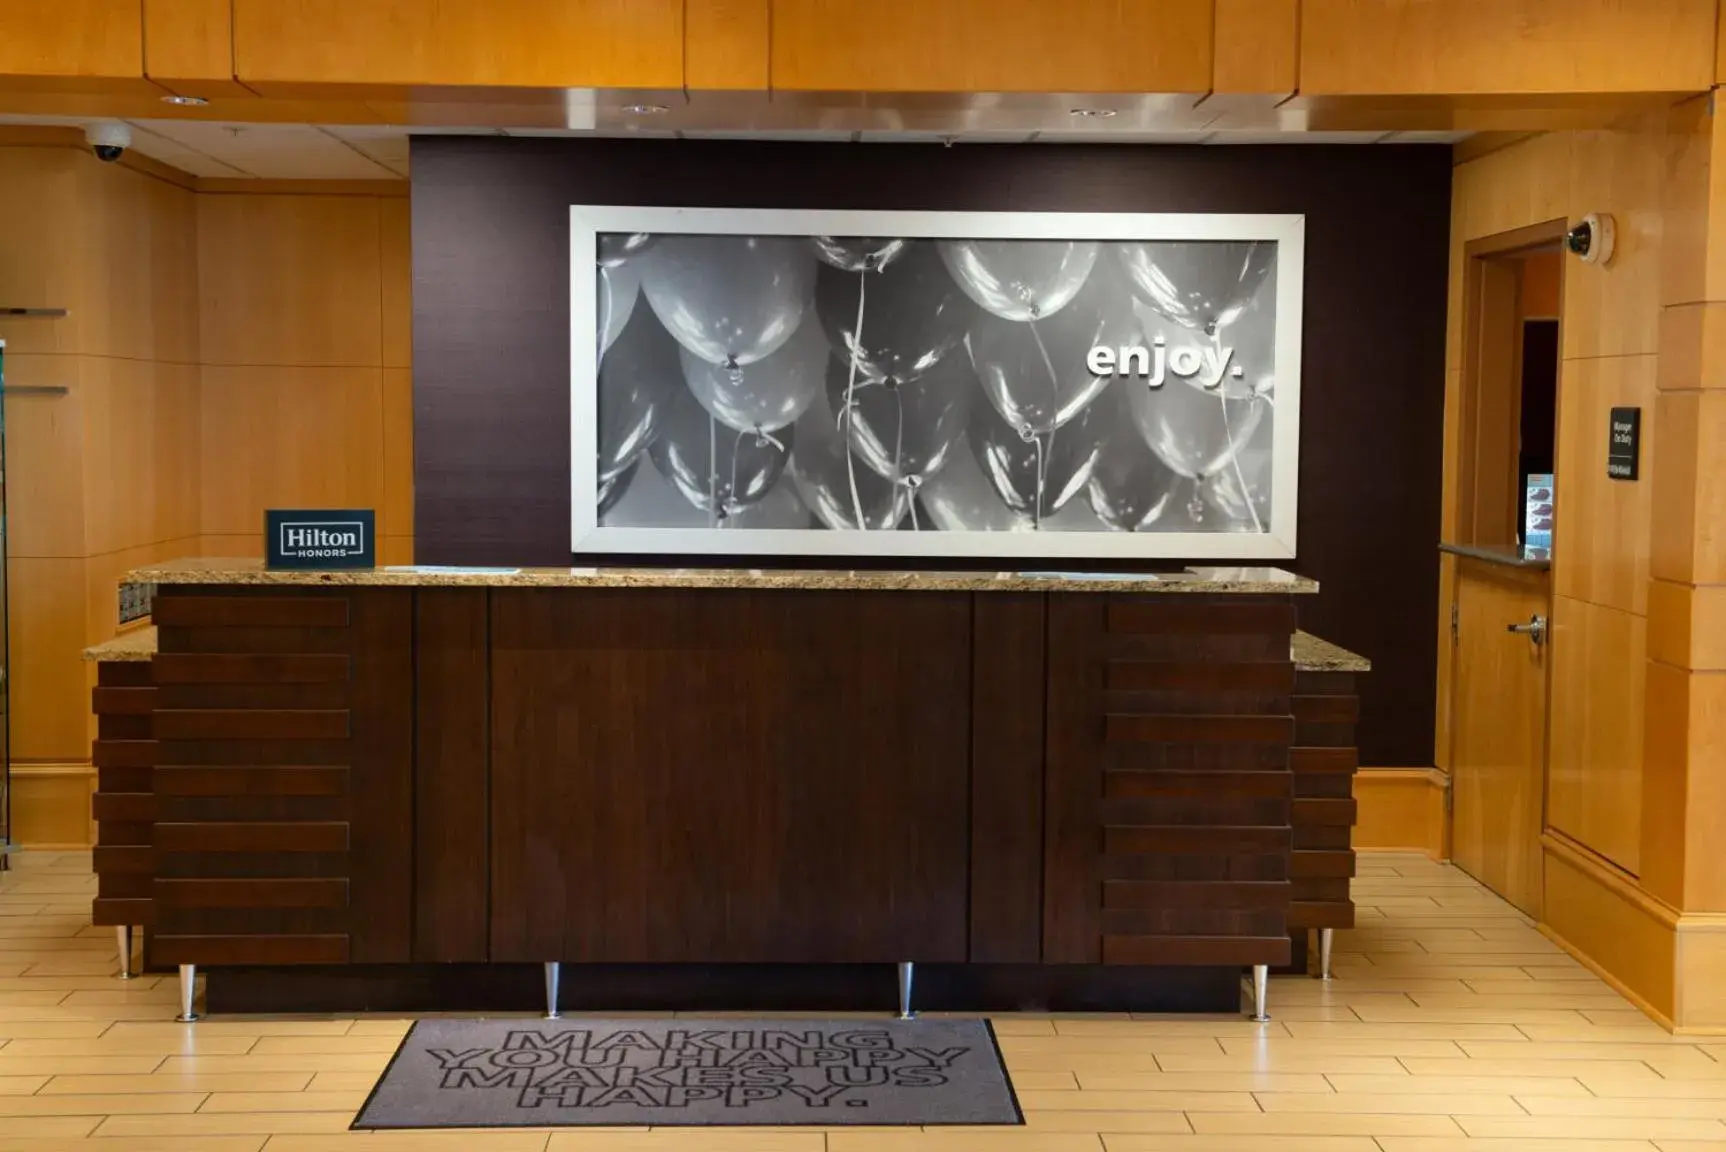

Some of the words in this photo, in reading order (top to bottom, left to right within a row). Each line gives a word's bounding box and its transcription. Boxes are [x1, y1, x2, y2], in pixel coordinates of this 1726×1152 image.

[1087, 336, 1243, 389] enjoy.
[287, 529, 356, 547] Hilton
[298, 549, 346, 557] HONORS
[502, 1030, 893, 1050] MAKING
[427, 1048, 626, 1068] YOU
[659, 1047, 970, 1068] HAPPY
[439, 1066, 793, 1088] MAKES
[826, 1065, 949, 1087] US
[516, 1085, 868, 1108] HAPPY.
